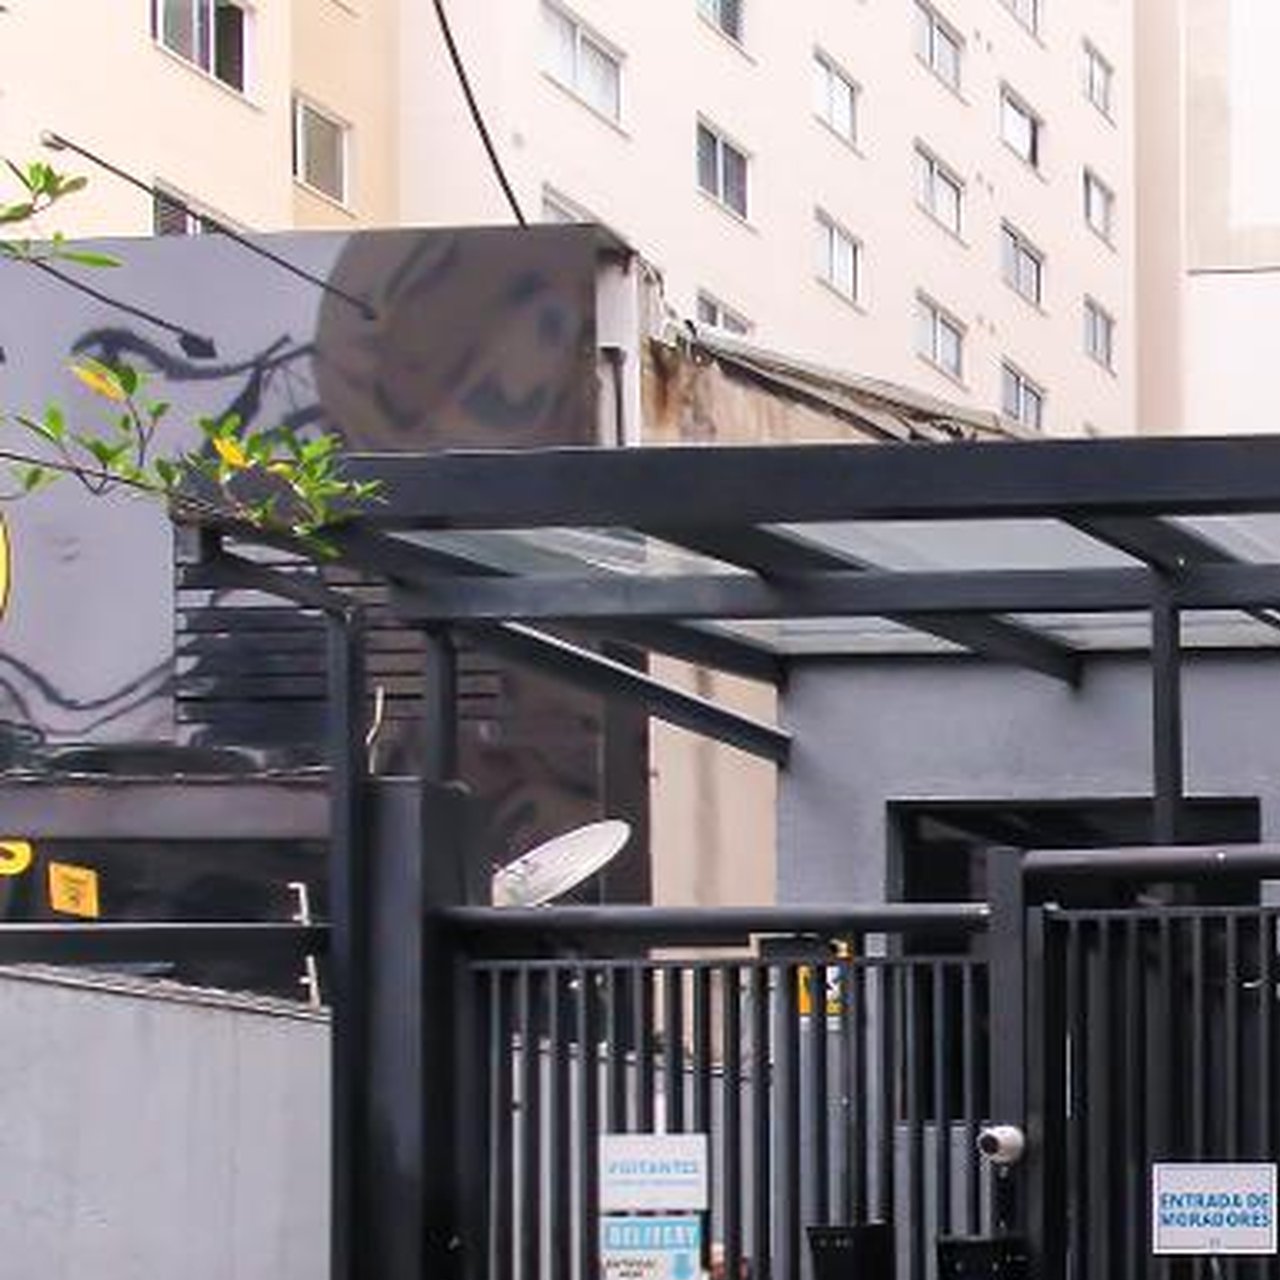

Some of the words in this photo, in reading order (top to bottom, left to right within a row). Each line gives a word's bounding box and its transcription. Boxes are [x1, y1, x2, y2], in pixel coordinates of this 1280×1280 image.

[1161, 1193, 1243, 1208] ENTRADA
[1246, 1192, 1270, 1208] DE
[1161, 1212, 1272, 1227] MORADORES
